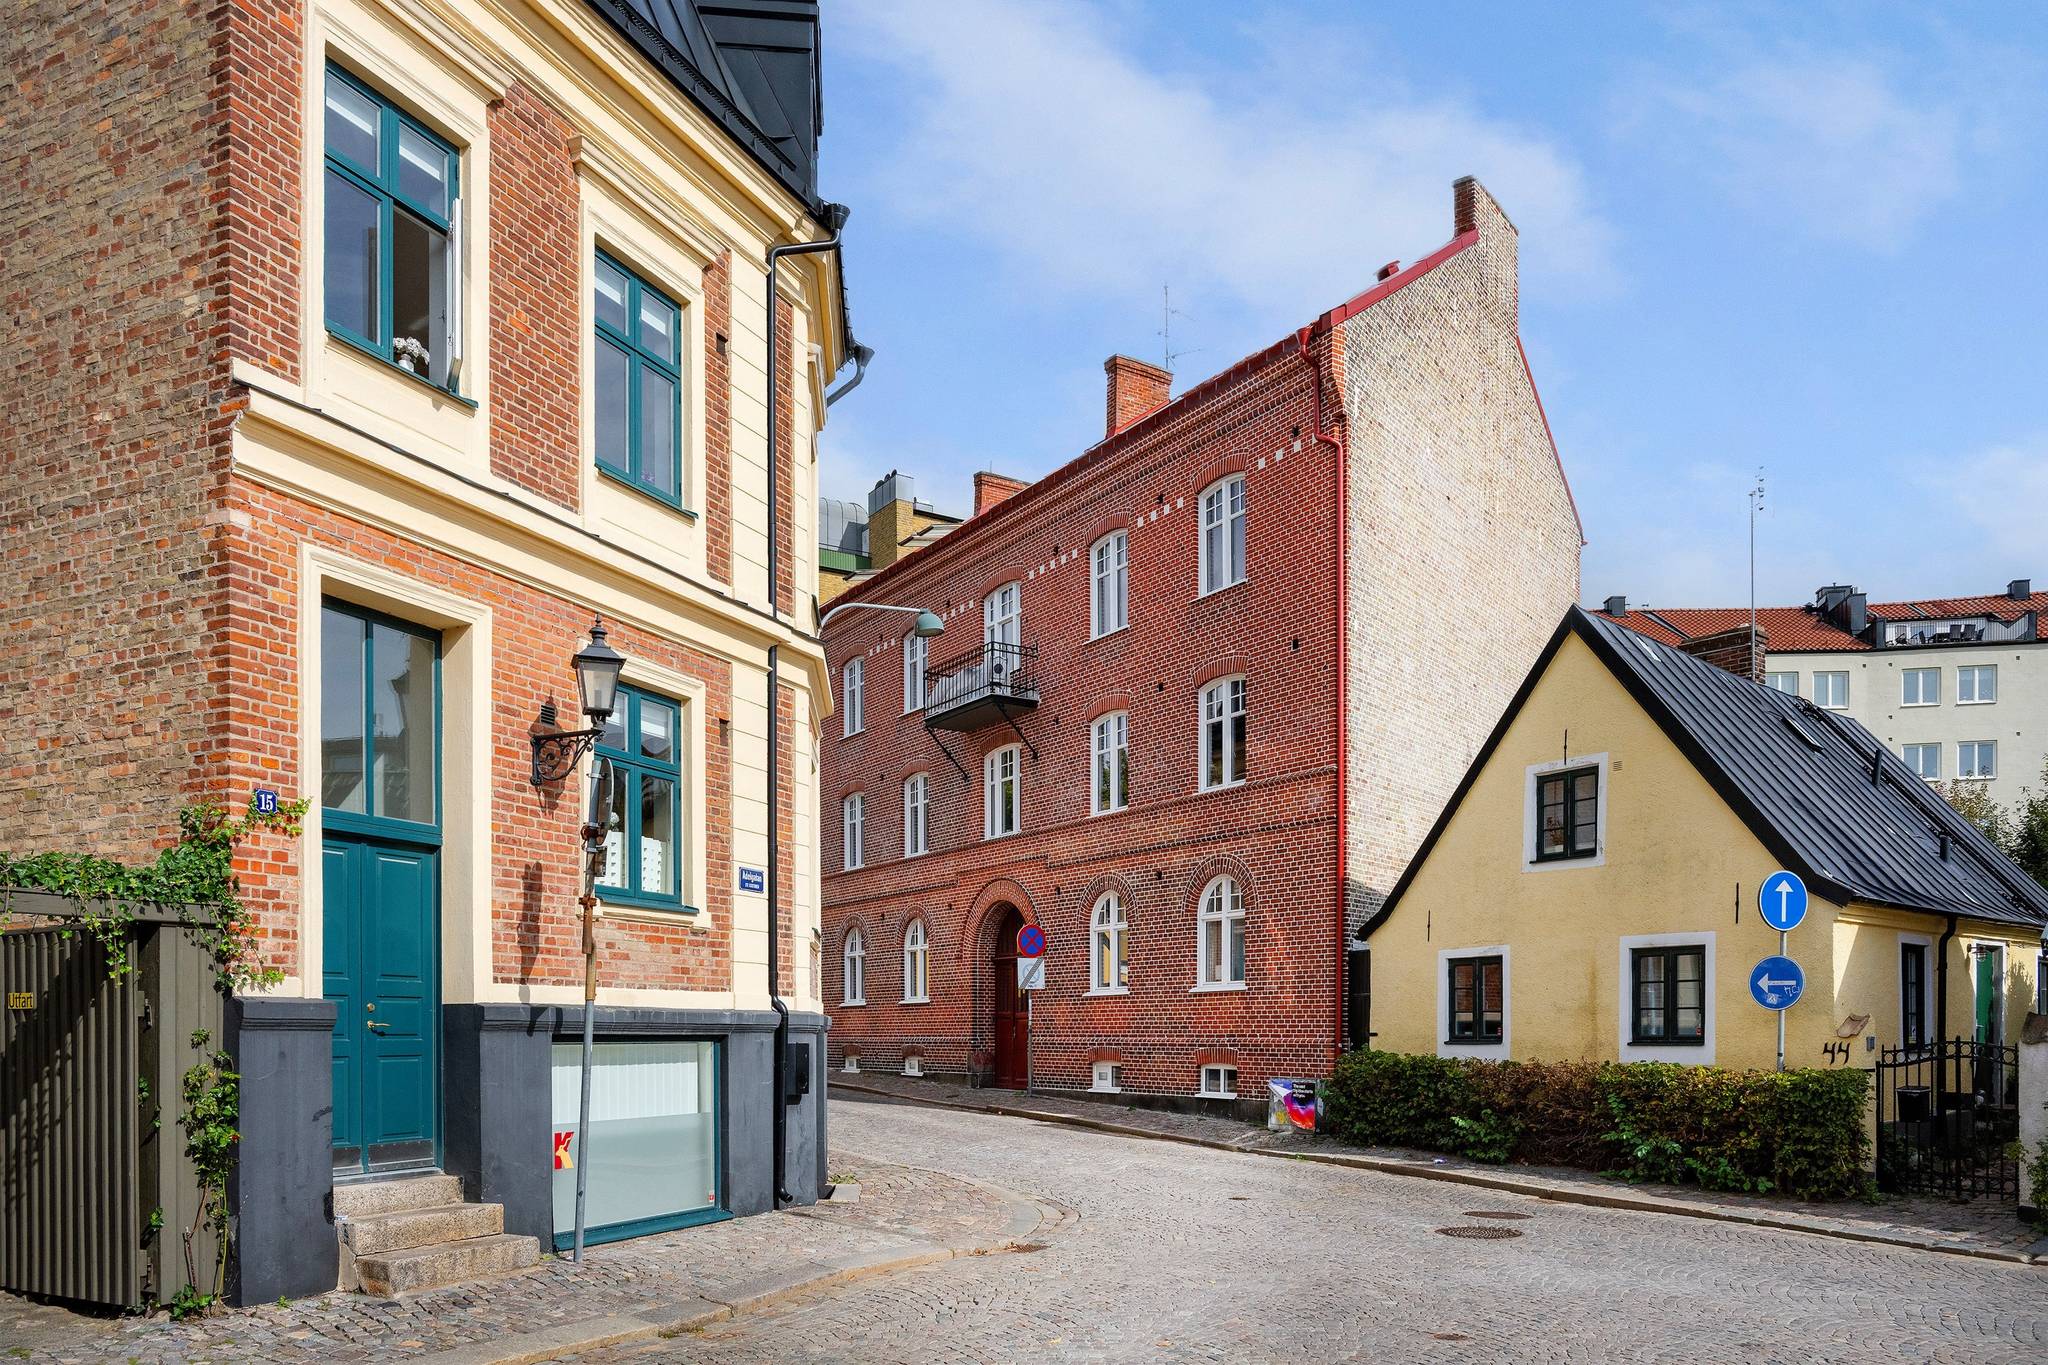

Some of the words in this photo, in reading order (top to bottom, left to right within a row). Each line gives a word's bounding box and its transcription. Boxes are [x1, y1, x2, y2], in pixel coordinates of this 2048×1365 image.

[260, 794, 273, 810] 15
[9, 993, 33, 1008] Utfart
[1823, 1041, 1850, 1065] 44
